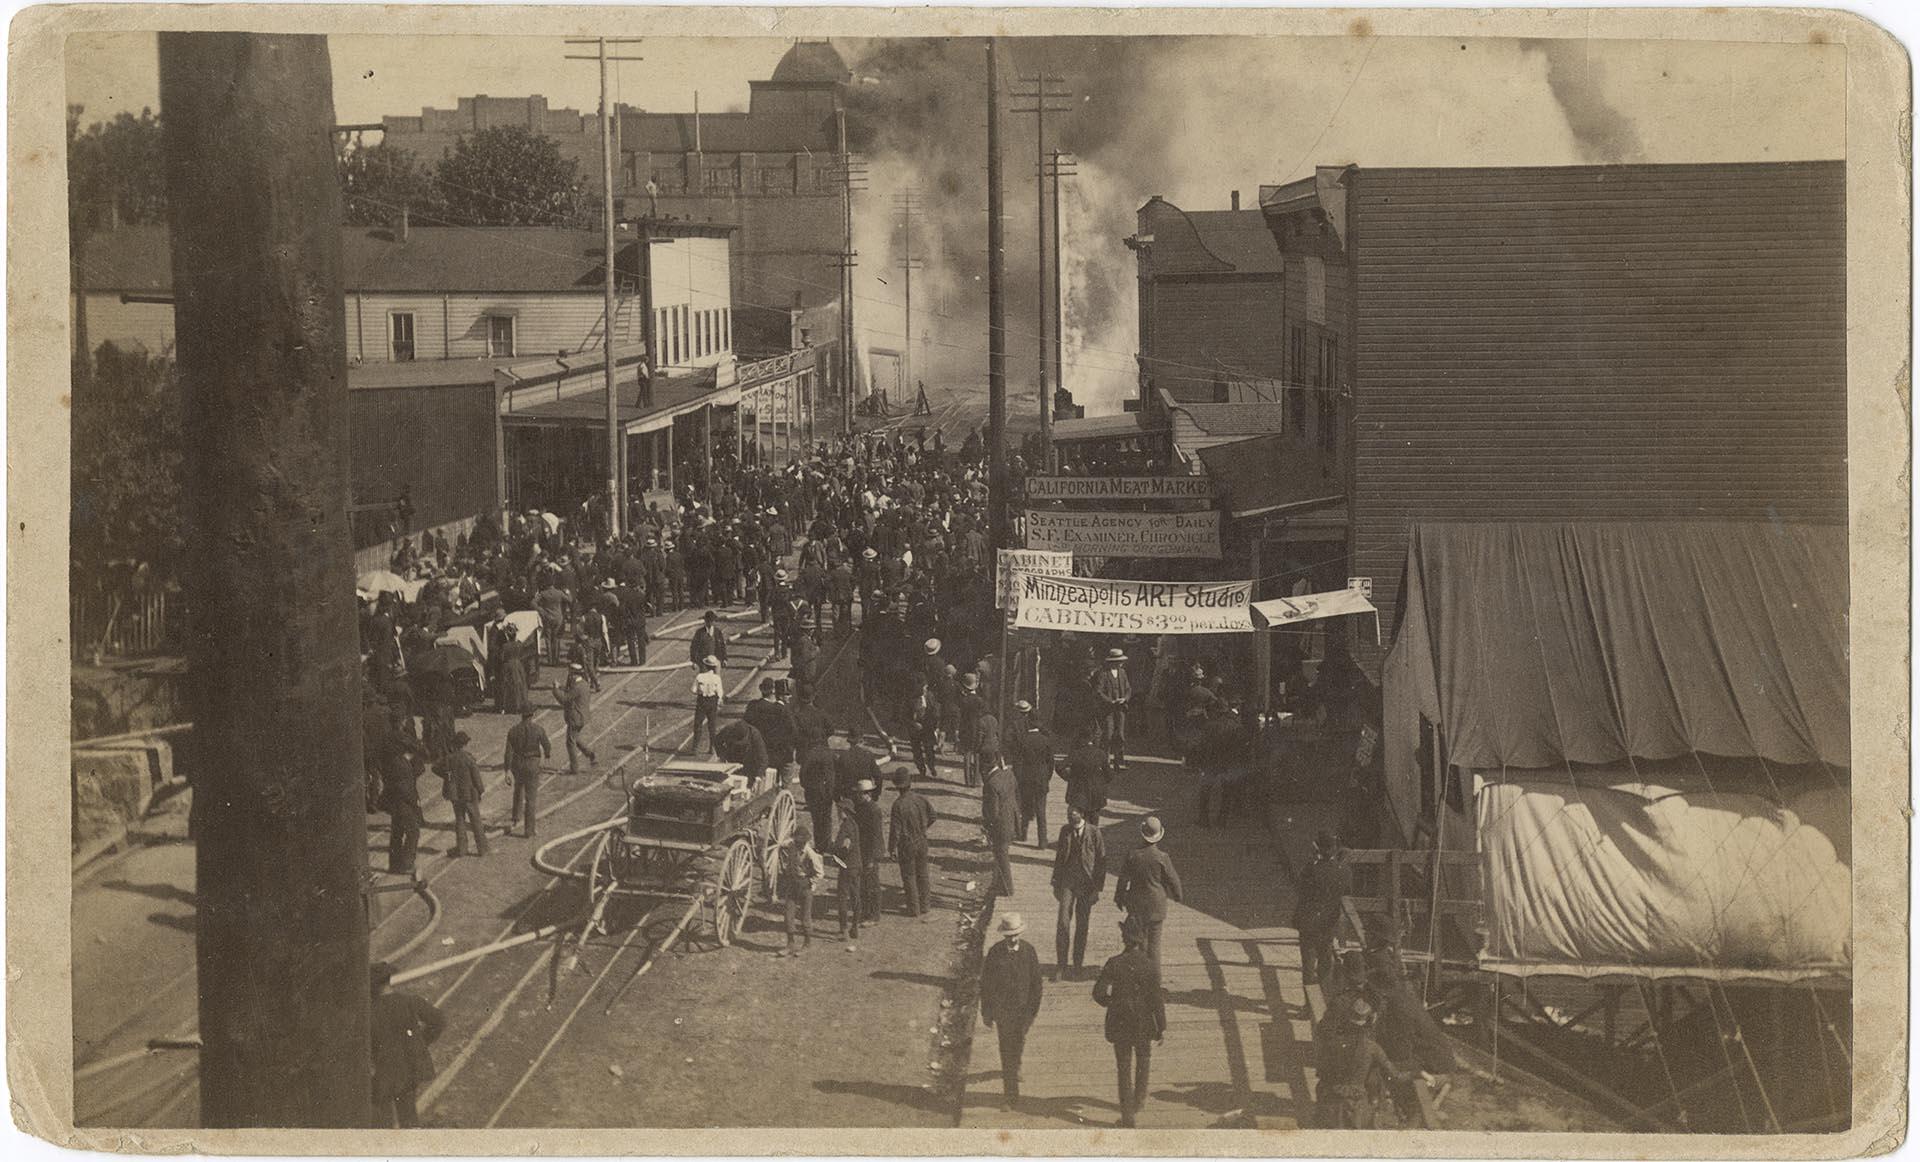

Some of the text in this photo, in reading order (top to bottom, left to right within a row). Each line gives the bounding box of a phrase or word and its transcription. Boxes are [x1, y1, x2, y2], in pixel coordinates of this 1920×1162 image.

[1028, 478, 1217, 495] CALIFORNIA MEAT MARKET
[1030, 512, 1088, 528] SEATTLE
[1091, 514, 1142, 528] AGENCY
[1175, 515, 1215, 528] DAILY
[1025, 576, 1132, 608] Minneapolis
[1135, 583, 1179, 608] ART
[1184, 583, 1245, 608] Studio
[1024, 606, 1143, 630] CABINETS
